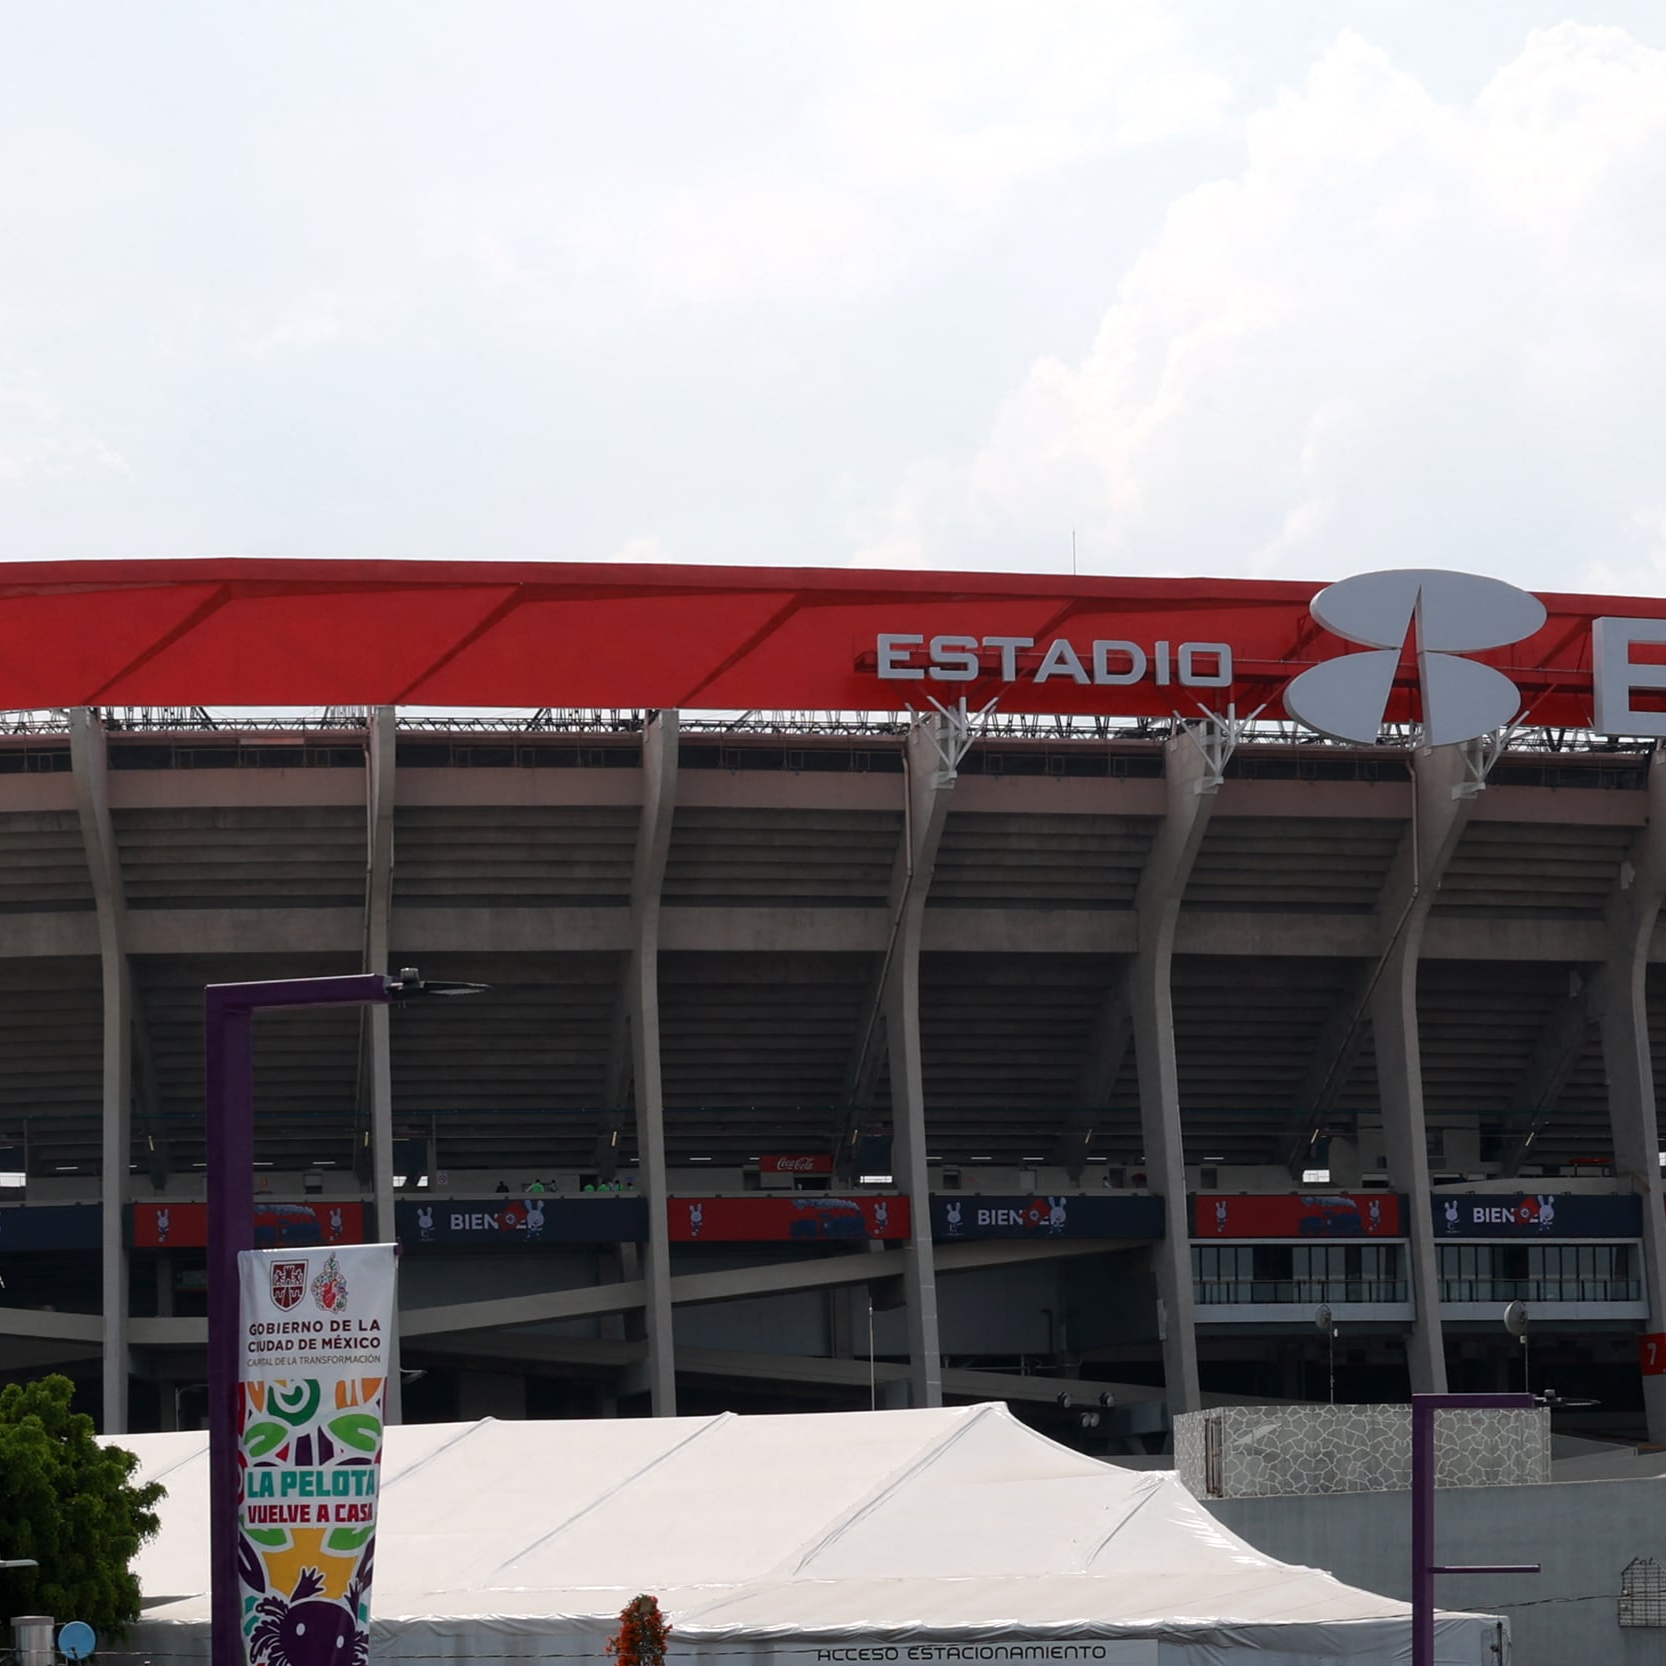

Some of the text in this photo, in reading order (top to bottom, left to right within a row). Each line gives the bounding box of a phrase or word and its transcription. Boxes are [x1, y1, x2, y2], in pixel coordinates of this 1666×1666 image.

[877, 633, 1232, 687] ESTADIO
[249, 1319, 381, 1336] GOBIERNO DE LA
[248, 1335, 380, 1353] CIUDAD DE MÉXICO
[1647, 1342, 1657, 1365] 7
[275, 1356, 285, 1366] DE
[287, 1356, 297, 1365] LA
[299, 1354, 381, 1365] TRANSFORMACIÓN
[247, 1469, 375, 1498] LA PELOTA
[247, 1503, 373, 1523] VUELVE A CASA
[818, 1645, 1106, 1661] ACCESO ESTACIONAMIENTO
